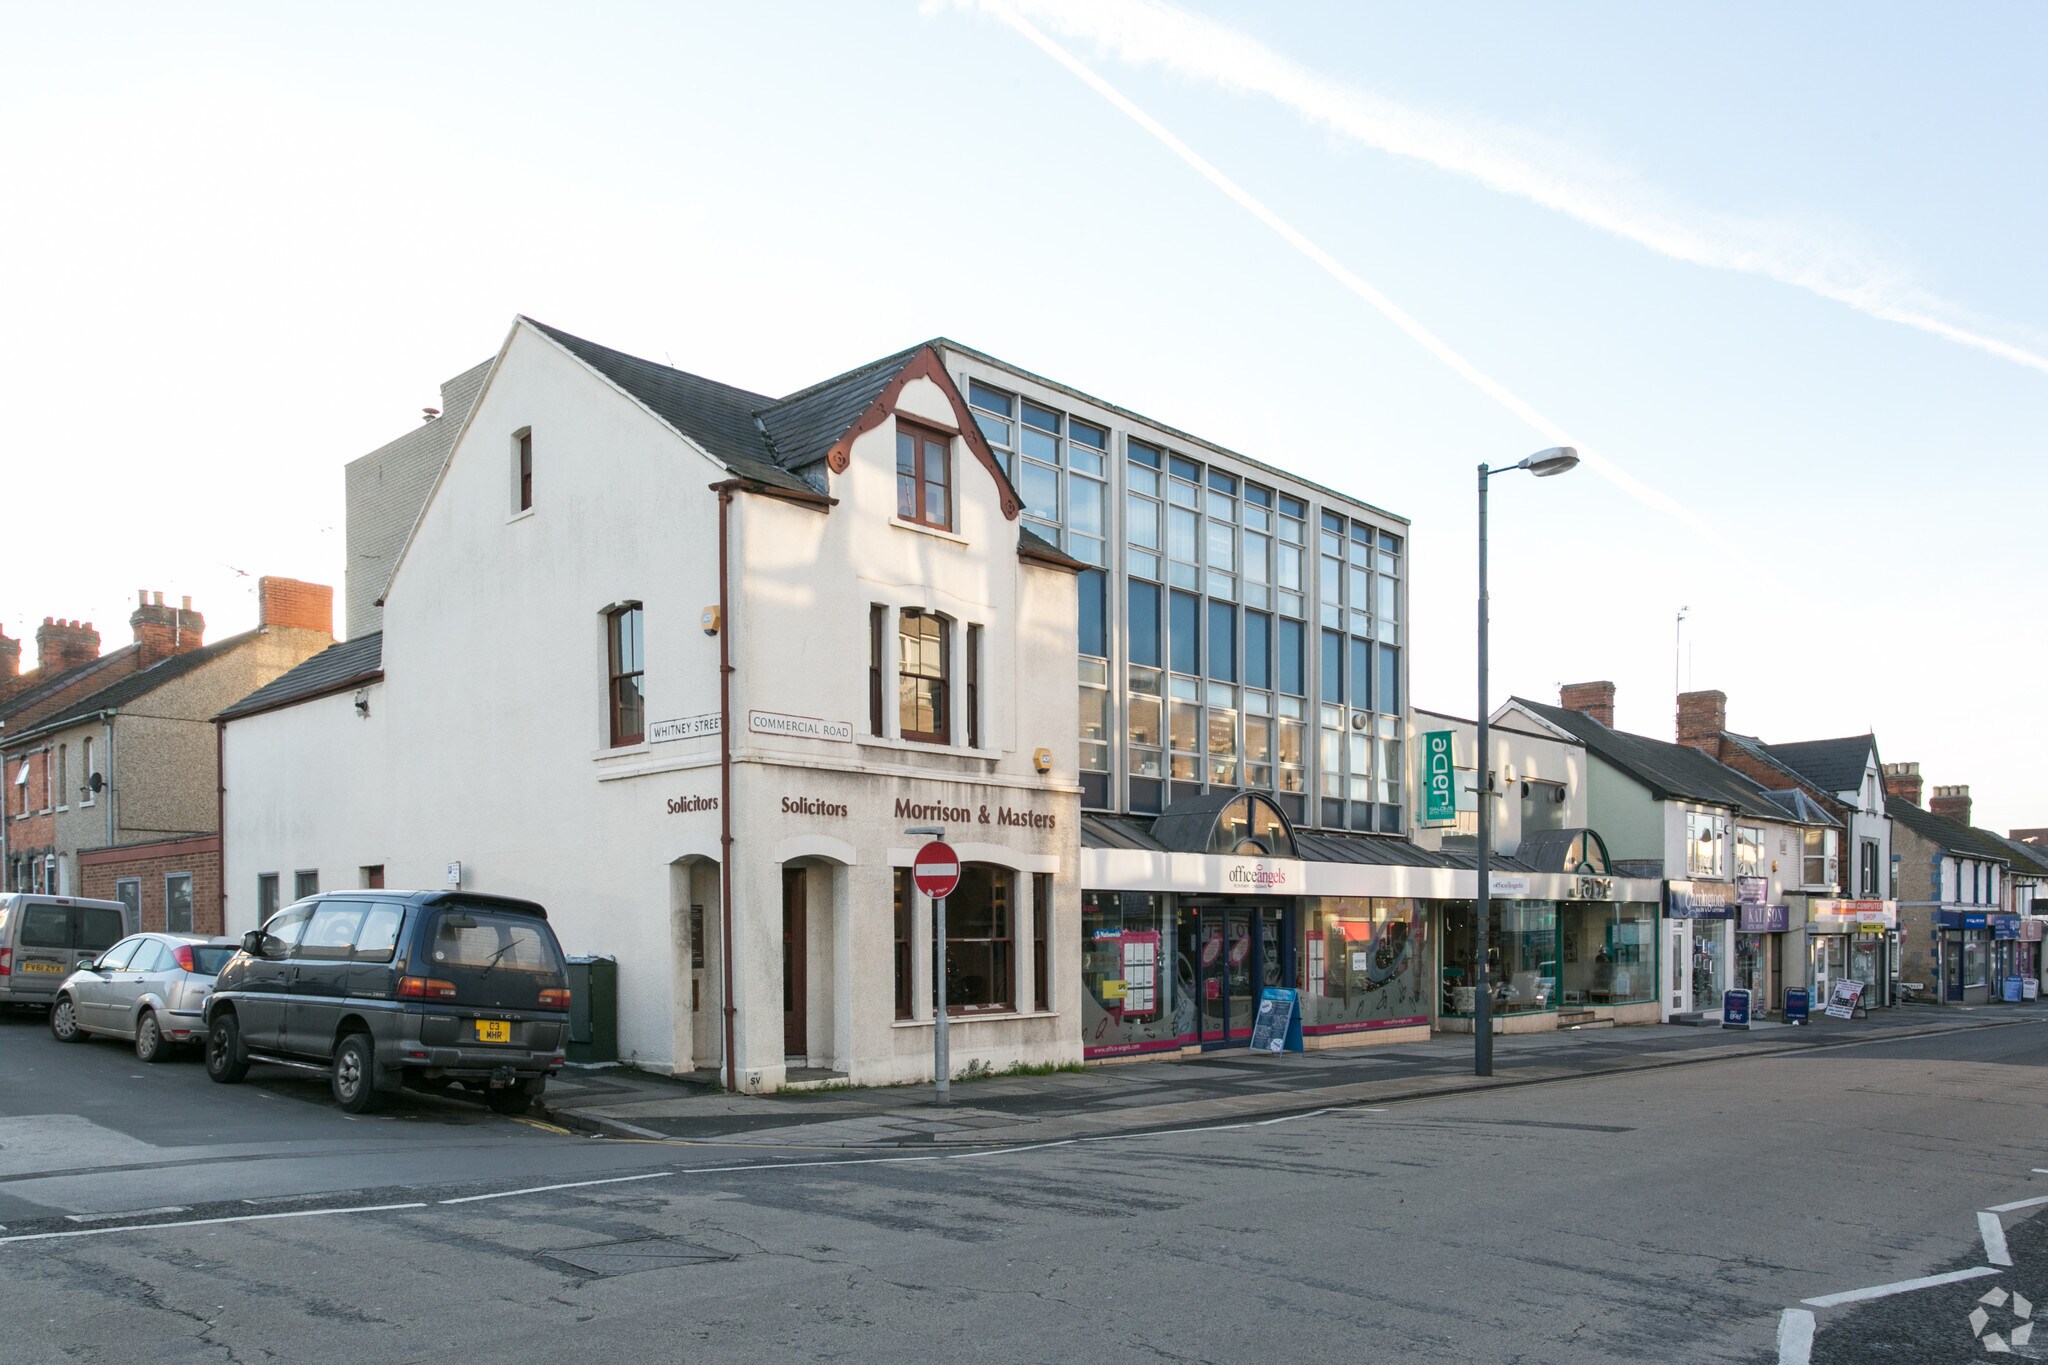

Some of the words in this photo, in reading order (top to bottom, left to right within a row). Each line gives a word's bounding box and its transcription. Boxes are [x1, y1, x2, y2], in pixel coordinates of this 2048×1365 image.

[653, 722, 691, 738] WHITNEY
[753, 716, 819, 734] COMMERCIAL
[823, 725, 849, 738] ROAD
[667, 794, 719, 814] Solicitors
[781, 796, 848, 817] Solicitors
[894, 797, 971, 823] Morrison
[977, 804, 991, 825] &
[997, 805, 1056, 829] Masters
[25, 963, 44, 971] FV61
[45, 964, 62, 972] ZYX
[1094, 1043, 1141, 1054] www.office-angels.com
[750, 1077, 761, 1085] SV
